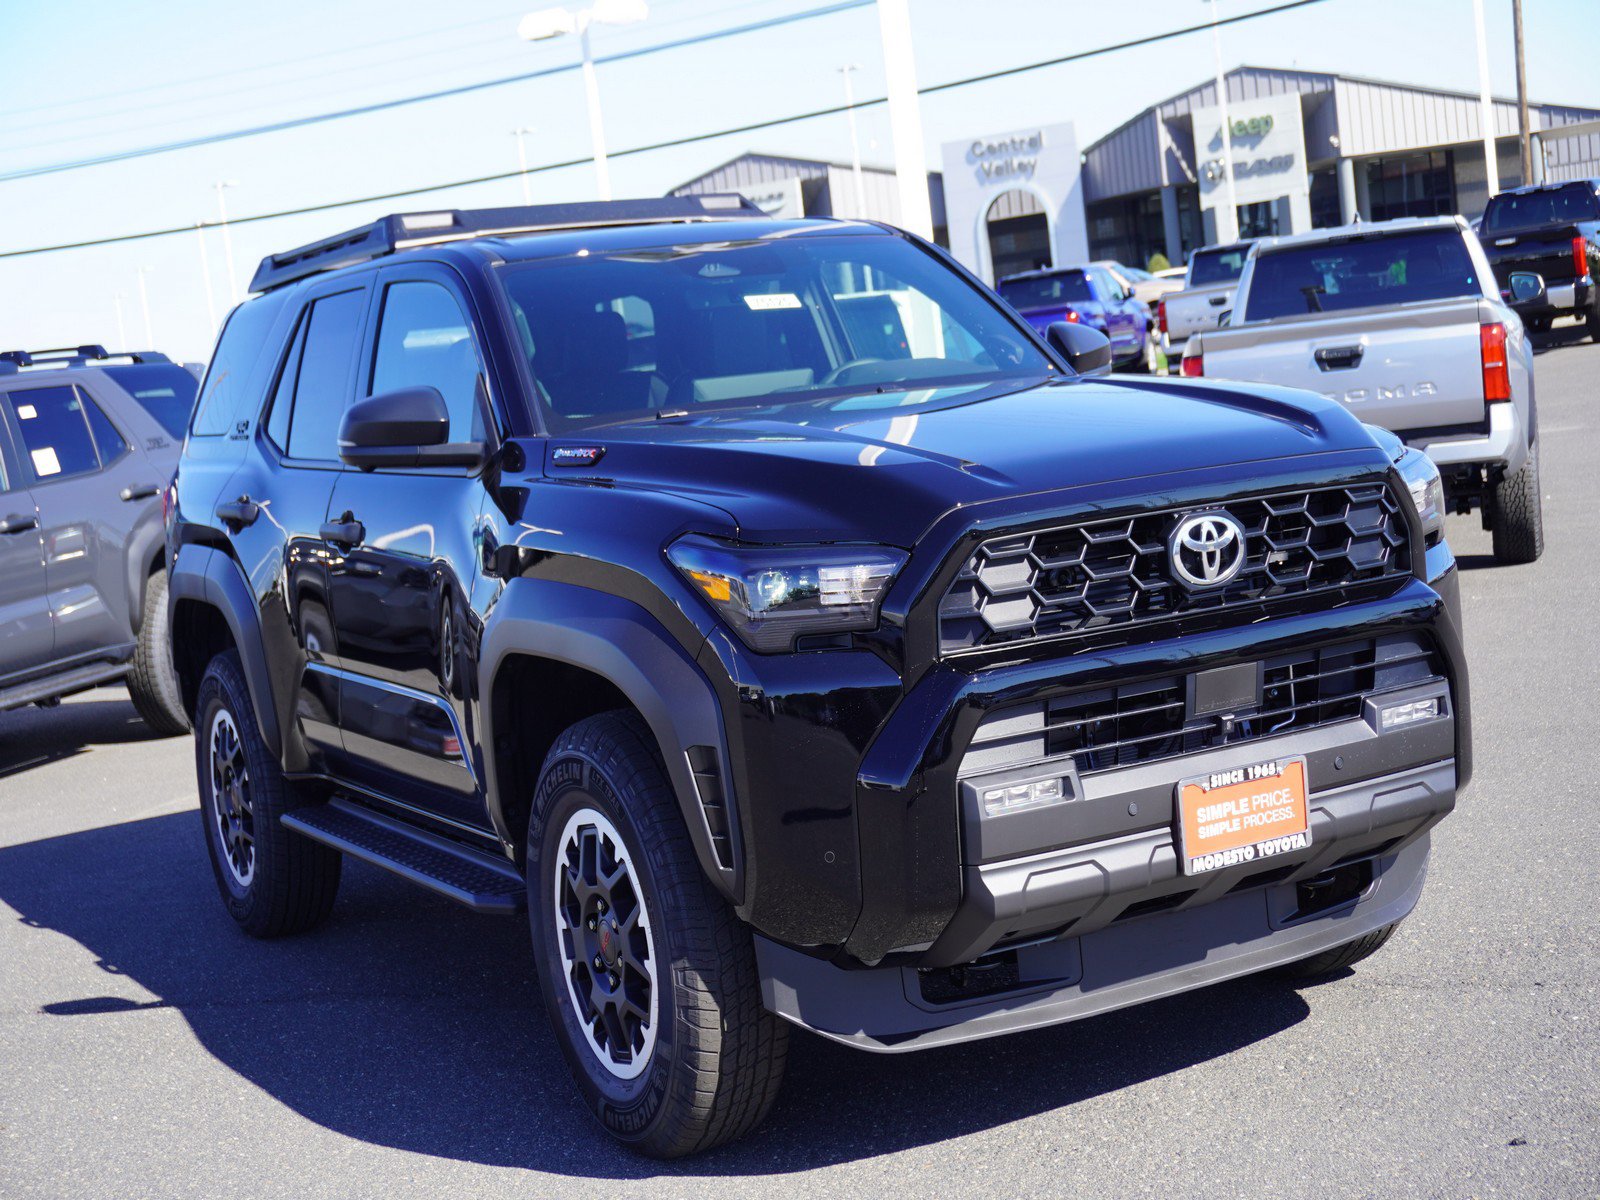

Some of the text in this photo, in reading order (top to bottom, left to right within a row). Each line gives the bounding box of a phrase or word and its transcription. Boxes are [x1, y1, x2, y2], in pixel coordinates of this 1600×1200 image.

[971, 130, 1043, 157] Central
[981, 156, 1037, 178] Valley
[536, 762, 582, 814] MICHELIN
[1211, 770, 1244, 787] SINCE
[1196, 789, 1294, 823] SIMPLE PRICE.
[1198, 806, 1295, 839] SIMPLE PROCESS.
[1192, 833, 1307, 873] MODESTO TOYOTA
